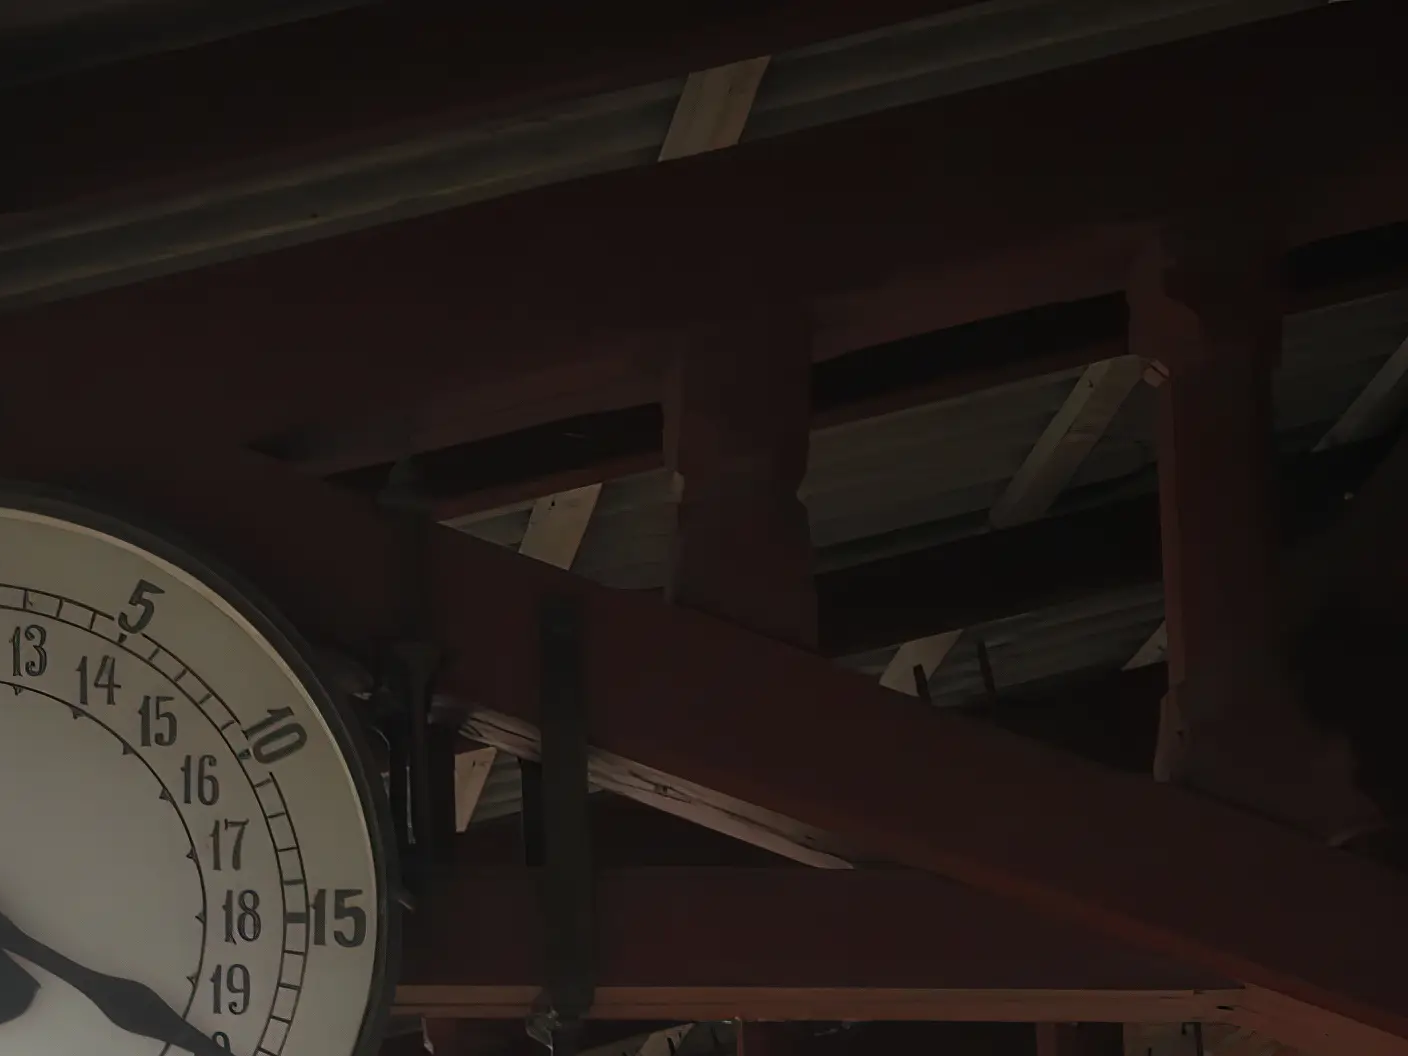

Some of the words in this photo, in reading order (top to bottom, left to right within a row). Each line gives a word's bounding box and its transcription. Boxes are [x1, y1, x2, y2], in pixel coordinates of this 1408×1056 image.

[118, 579, 165, 634] 5
[8, 624, 48, 677] 13
[76, 655, 122, 706] 14
[137, 695, 178, 747] 15
[244, 706, 308, 764] 10
[180, 754, 220, 806] 16
[209, 818, 250, 871] 17
[222, 889, 262, 944] 18
[309, 888, 367, 948] 15
[210, 963, 251, 1015] 19
